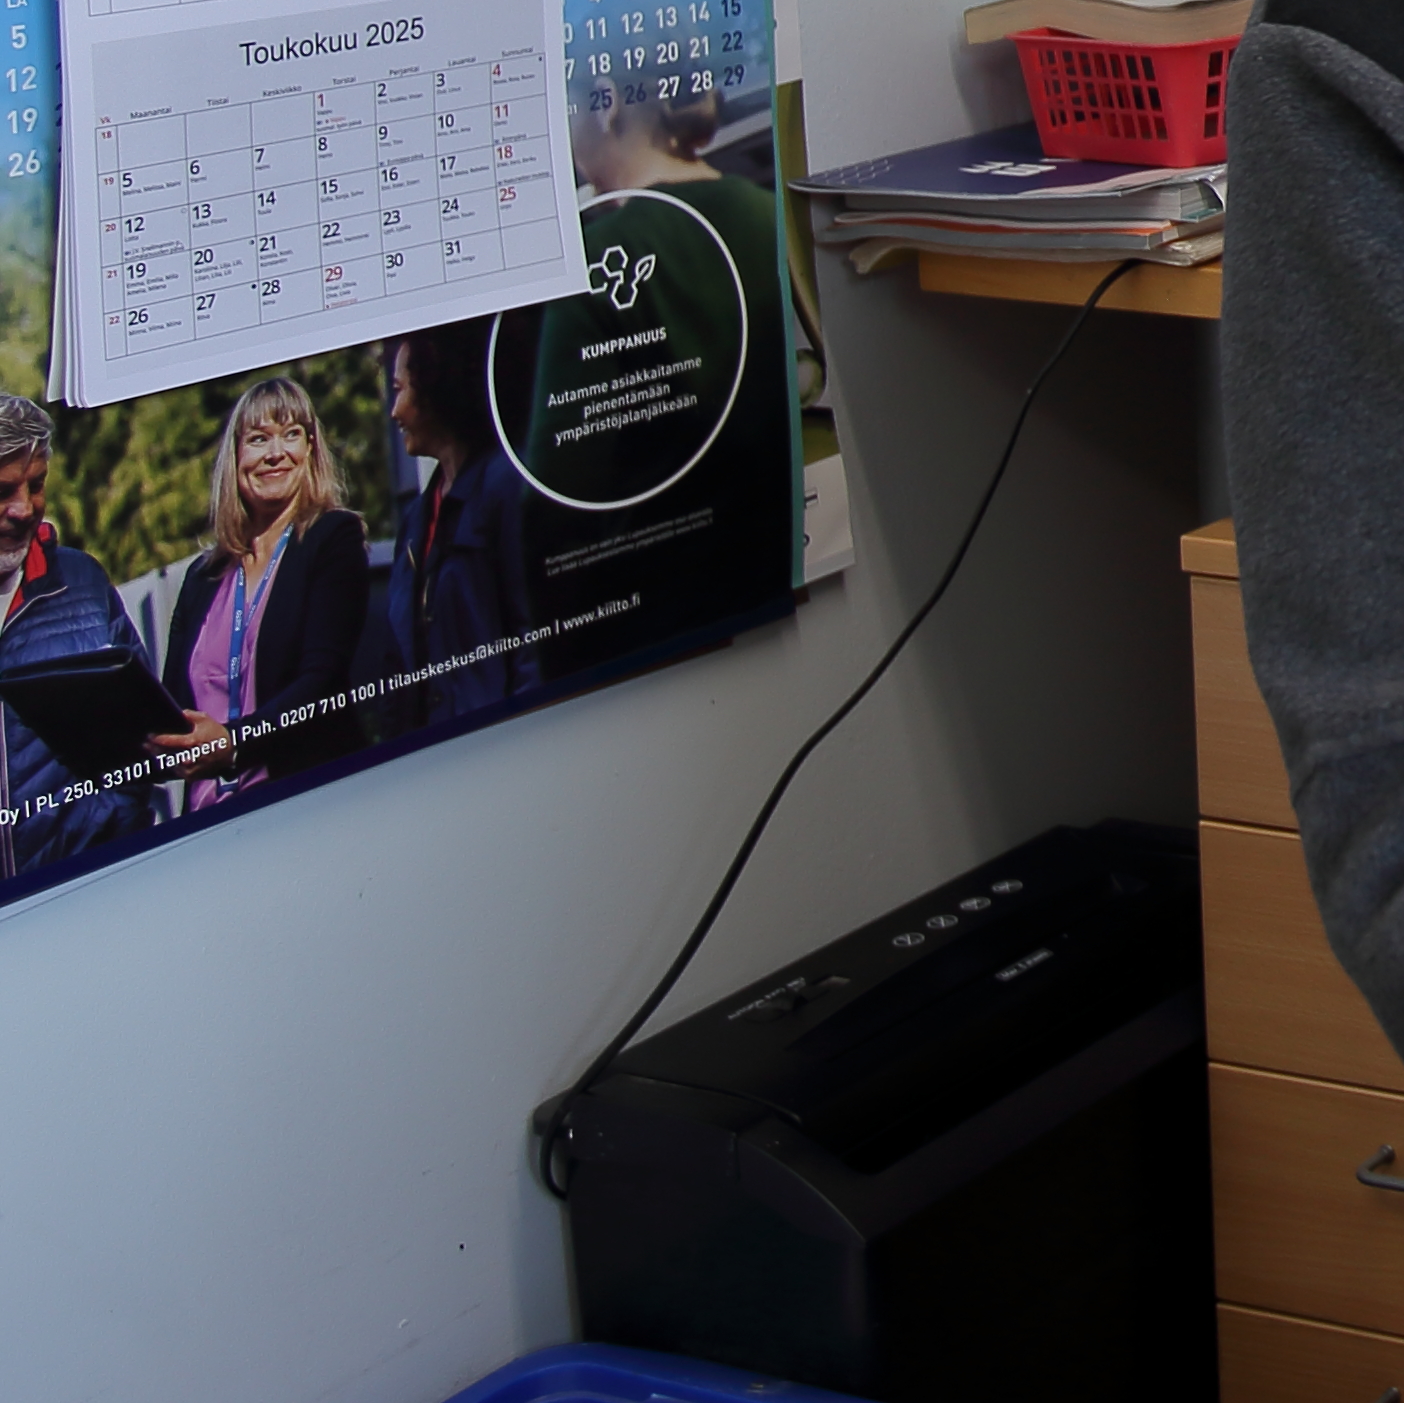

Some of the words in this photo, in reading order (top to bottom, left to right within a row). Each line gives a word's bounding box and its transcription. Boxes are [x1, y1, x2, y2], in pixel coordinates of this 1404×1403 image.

[239, 27, 358, 66] Toukokuu
[365, 16, 425, 48] 2025
[6, 66, 37, 93] 12
[589, 89, 613, 112] 25
[624, 83, 648, 106] 26
[658, 77, 681, 99] 27
[691, 71, 714, 93] 28
[723, 65, 745, 87] 29
[8, 149, 41, 178] 26
[128, 309, 149, 325] 26
[196, 293, 216, 311] 27
[261, 279, 281, 296] 28
[324, 265, 343, 283] 29
[385, 253, 404, 269] 30
[443, 240, 462, 257] 31
[581, 326, 668, 361] KUMPPANUUS
[548, 381, 609, 408] Autamme
[611, 355, 702, 393] asiakkaitamme
[583, 382, 671, 419] pienentämään
[555, 393, 698, 447] ympäristöjalanjälkeään
[37, 795, 59, 814] PL
[64, 779, 99, 804] 250,
[103, 760, 152, 789] 33101
[156, 737, 227, 772] Tampere
[242, 720, 277, 743] Puh.
[280, 703, 315, 728] 0207
[319, 694, 346, 715] 710
[350, 683, 375, 703] 100
[388, 625, 551, 691] tilauskeskus@kiilto.com
[563, 592, 641, 631] www.kiilto.fi
